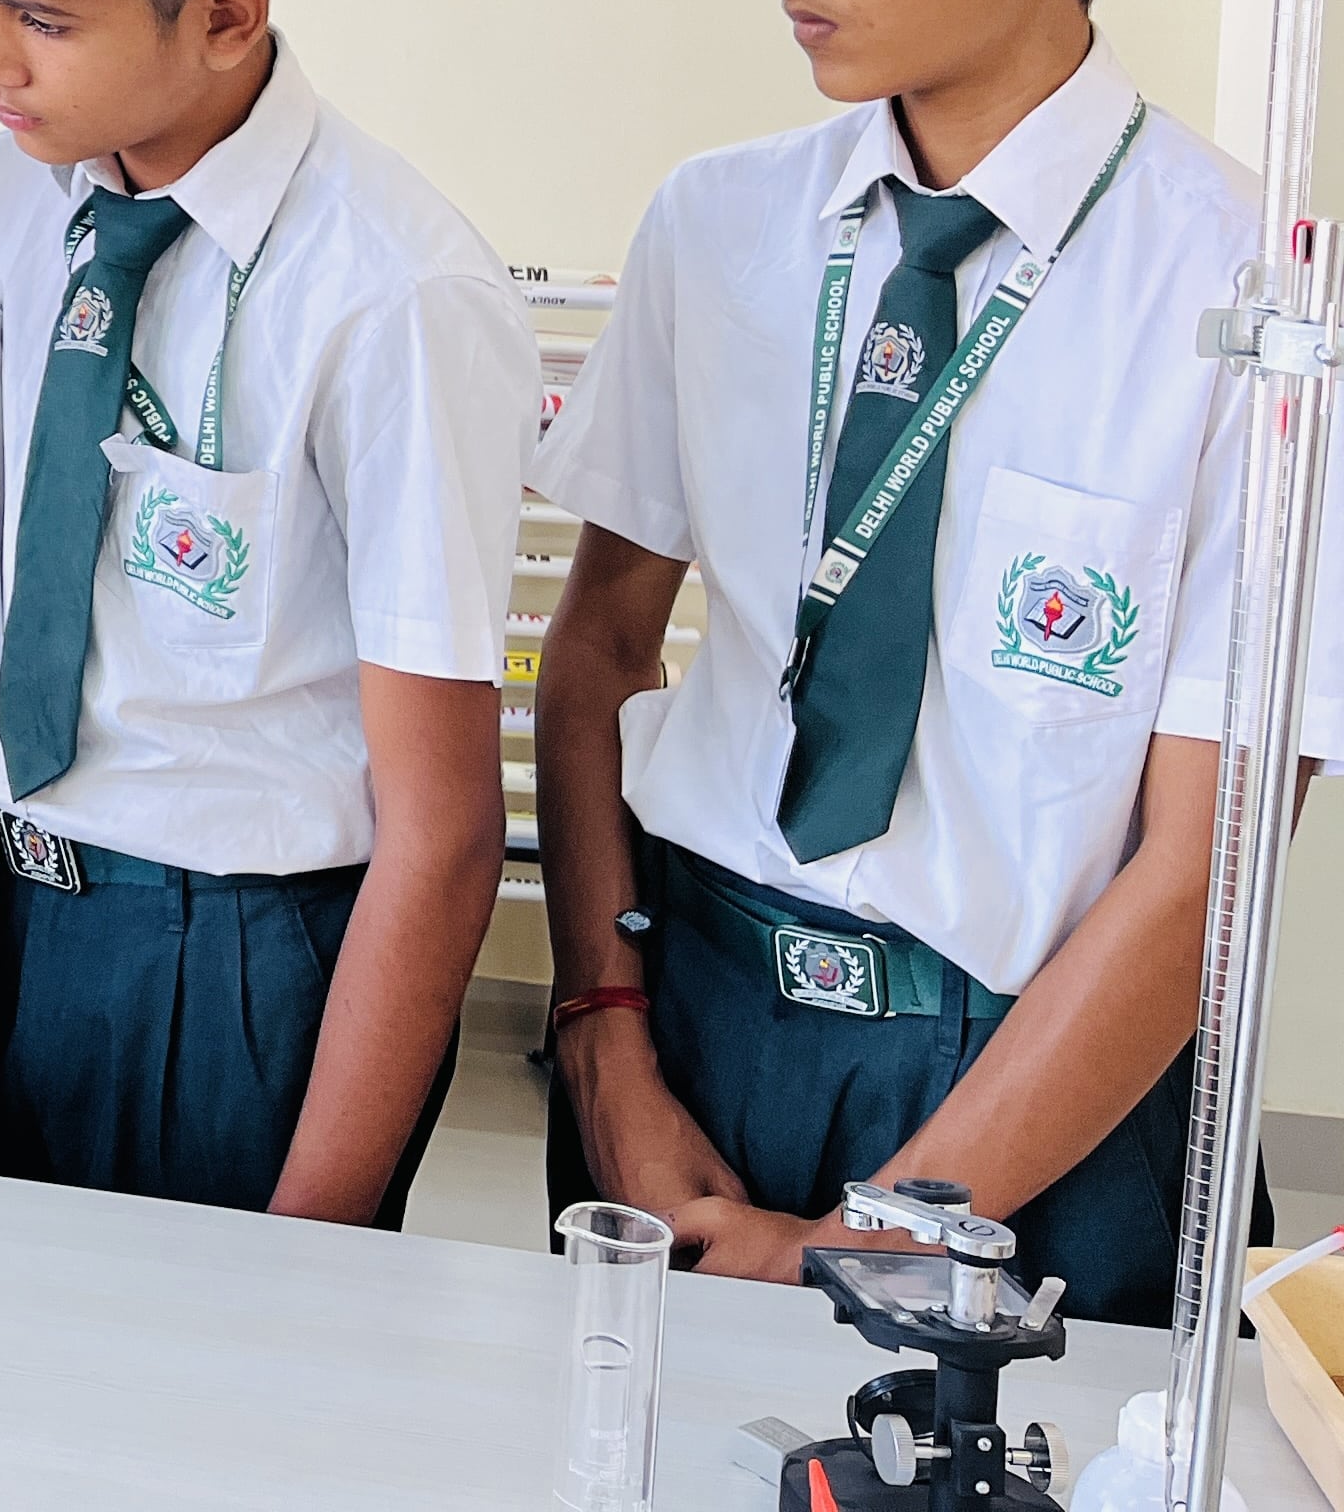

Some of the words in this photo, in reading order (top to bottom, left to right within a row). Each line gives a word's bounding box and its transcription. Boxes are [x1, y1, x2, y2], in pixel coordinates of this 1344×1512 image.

[825, 276, 846, 342] SCHOOL
[817, 345, 835, 403] PUBLIC
[200, 416, 216, 465] DELHI
[810, 407, 827, 470] WORLD
[855, 491, 895, 539] DELHI
[887, 435, 929, 494] WORLD
[921, 377, 968, 438] PUBLIC
[959, 315, 1010, 379] SCHOOL
[1009, 654, 1039, 671] WORLD
[1039, 659, 1074, 679] PUBLIC
[1077, 672, 1116, 695] SCHOOL
